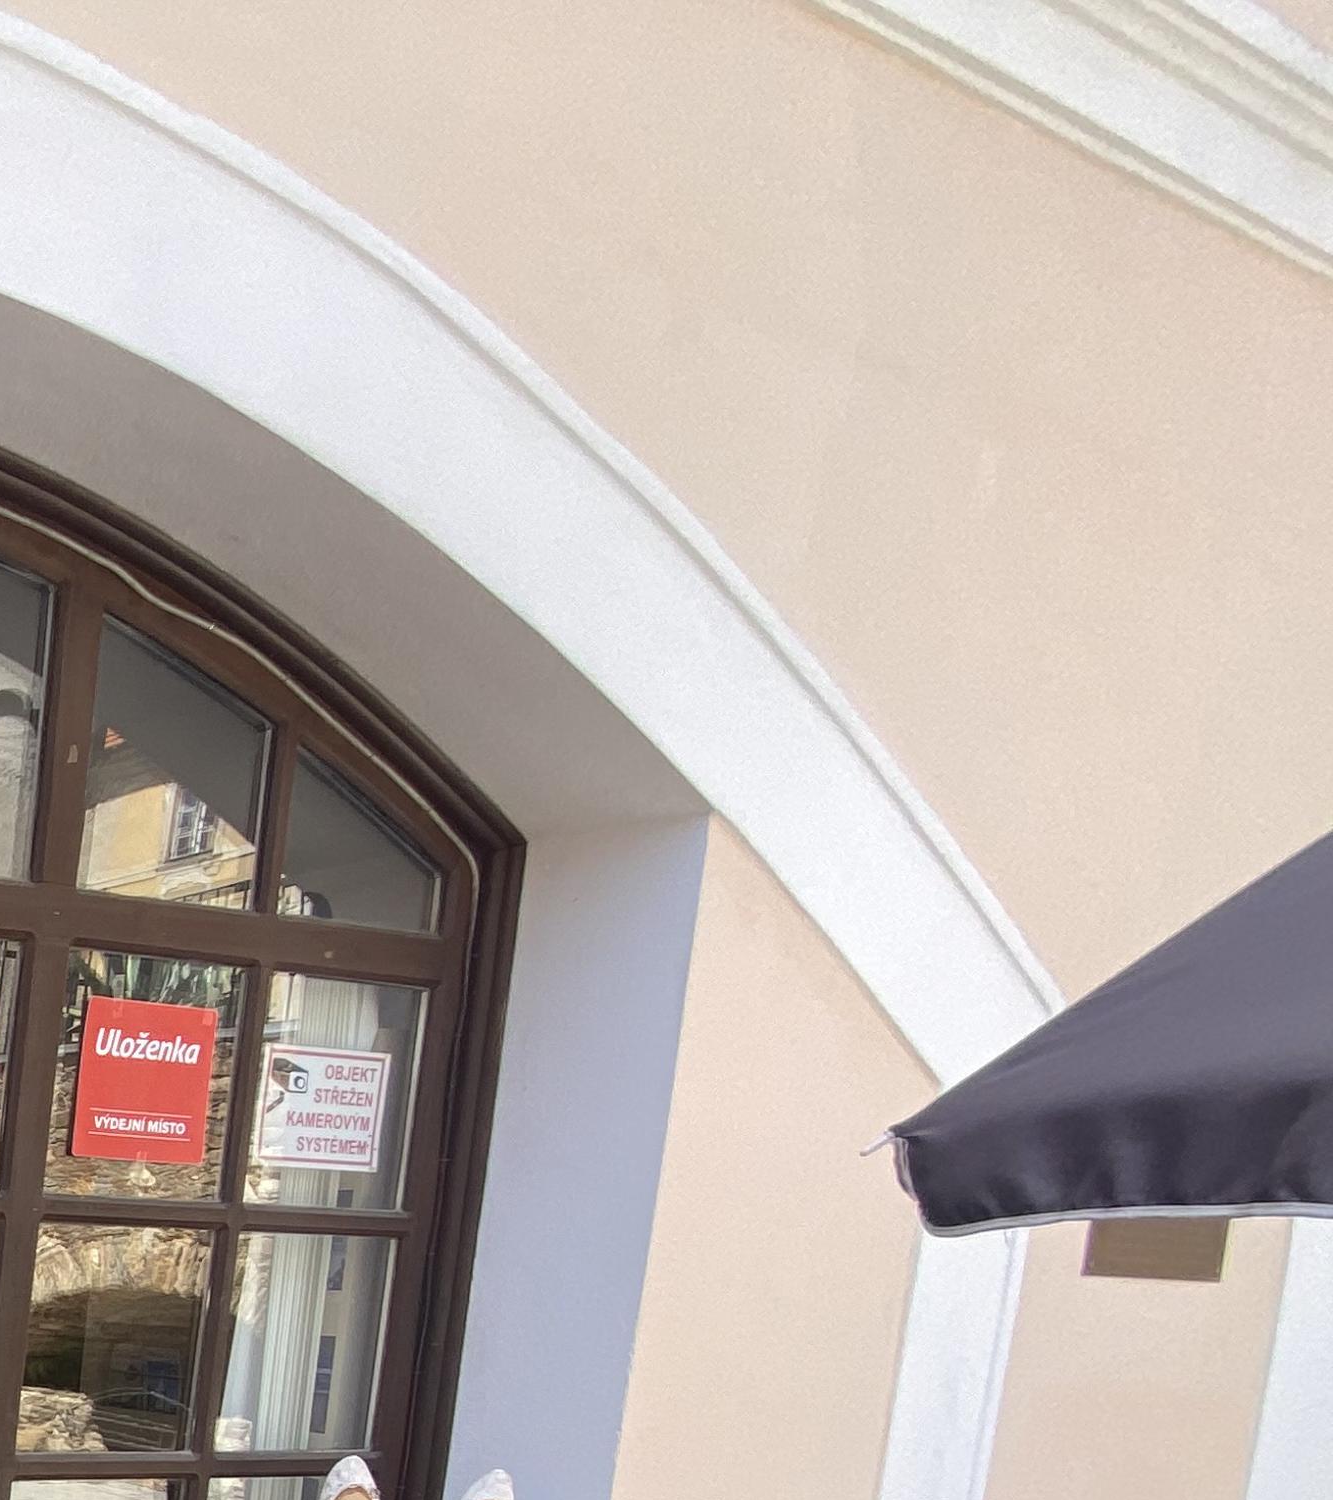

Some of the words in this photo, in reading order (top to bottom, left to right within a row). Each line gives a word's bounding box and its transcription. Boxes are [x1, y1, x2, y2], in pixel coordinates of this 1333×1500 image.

[95, 1027, 201, 1065] Uloženka
[324, 1064, 378, 1083] OBJEKT
[313, 1086, 374, 1107] STŘEŽEN
[94, 1113, 146, 1132] VÝDEJNÍ
[147, 1117, 186, 1135] MÍSTO
